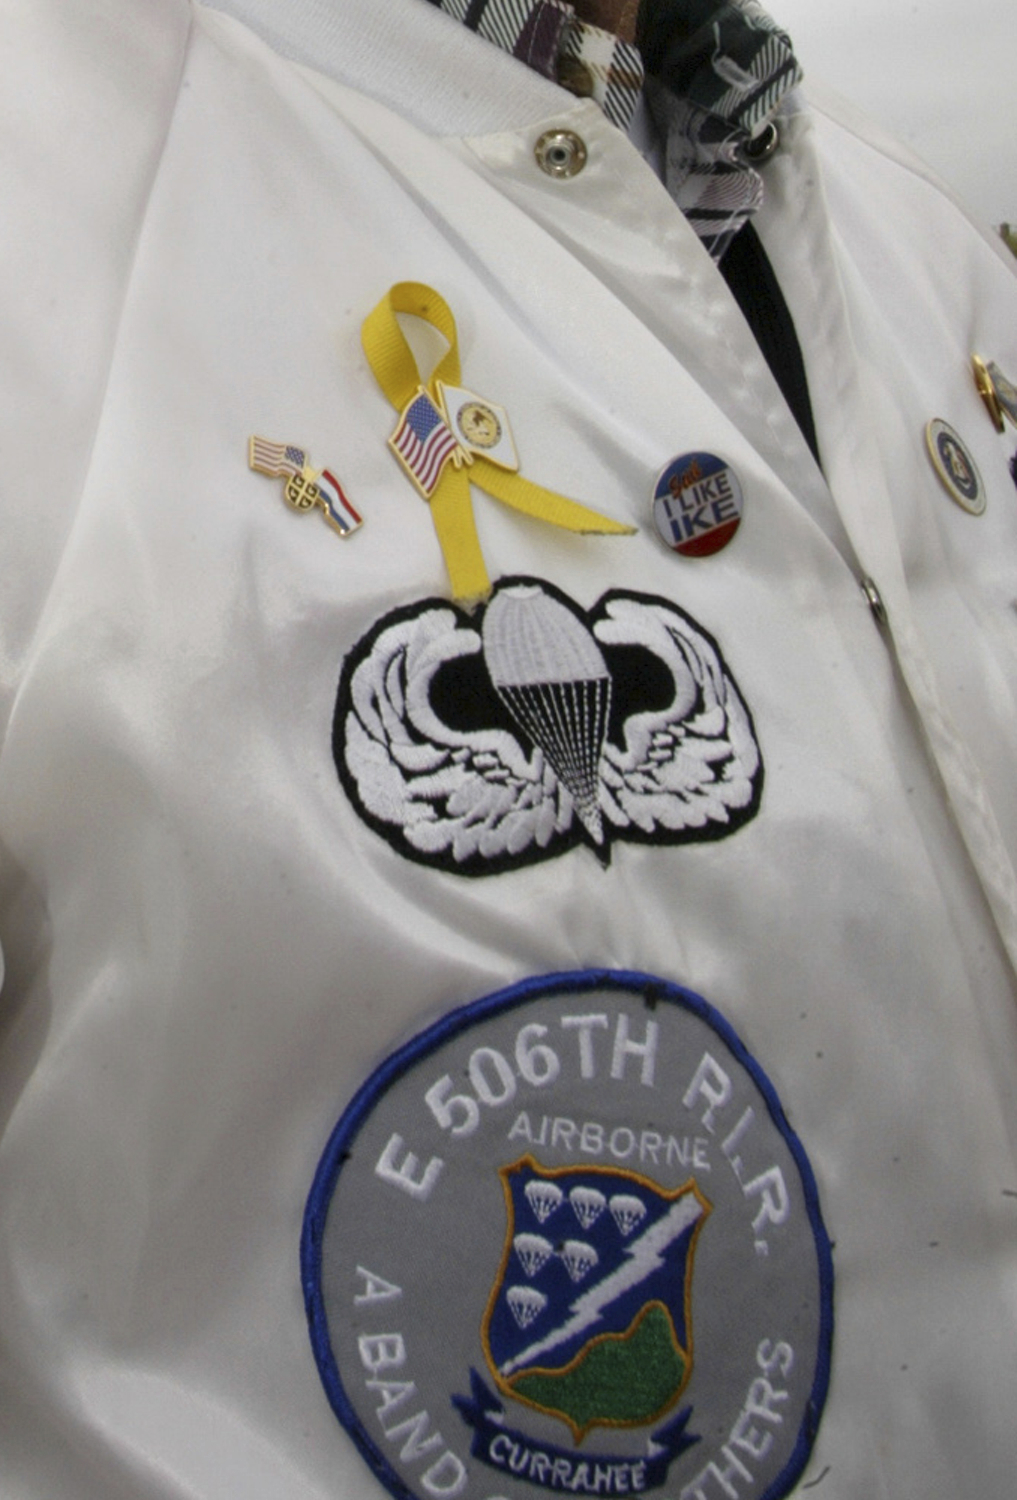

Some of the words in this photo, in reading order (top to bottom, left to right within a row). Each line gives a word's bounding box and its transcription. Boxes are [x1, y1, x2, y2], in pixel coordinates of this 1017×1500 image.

[662, 498, 673, 519] I
[678, 472, 732, 512] LIKE
[669, 493, 739, 543] IKE
[374, 1131, 445, 1201] E
[424, 1012, 660, 1139] 506TH
[507, 1110, 712, 1173] AIRBORNE
[353, 1264, 403, 1306] A
[357, 1331, 468, 1498] BAND
[489, 1433, 648, 1492] CURRAHEE
